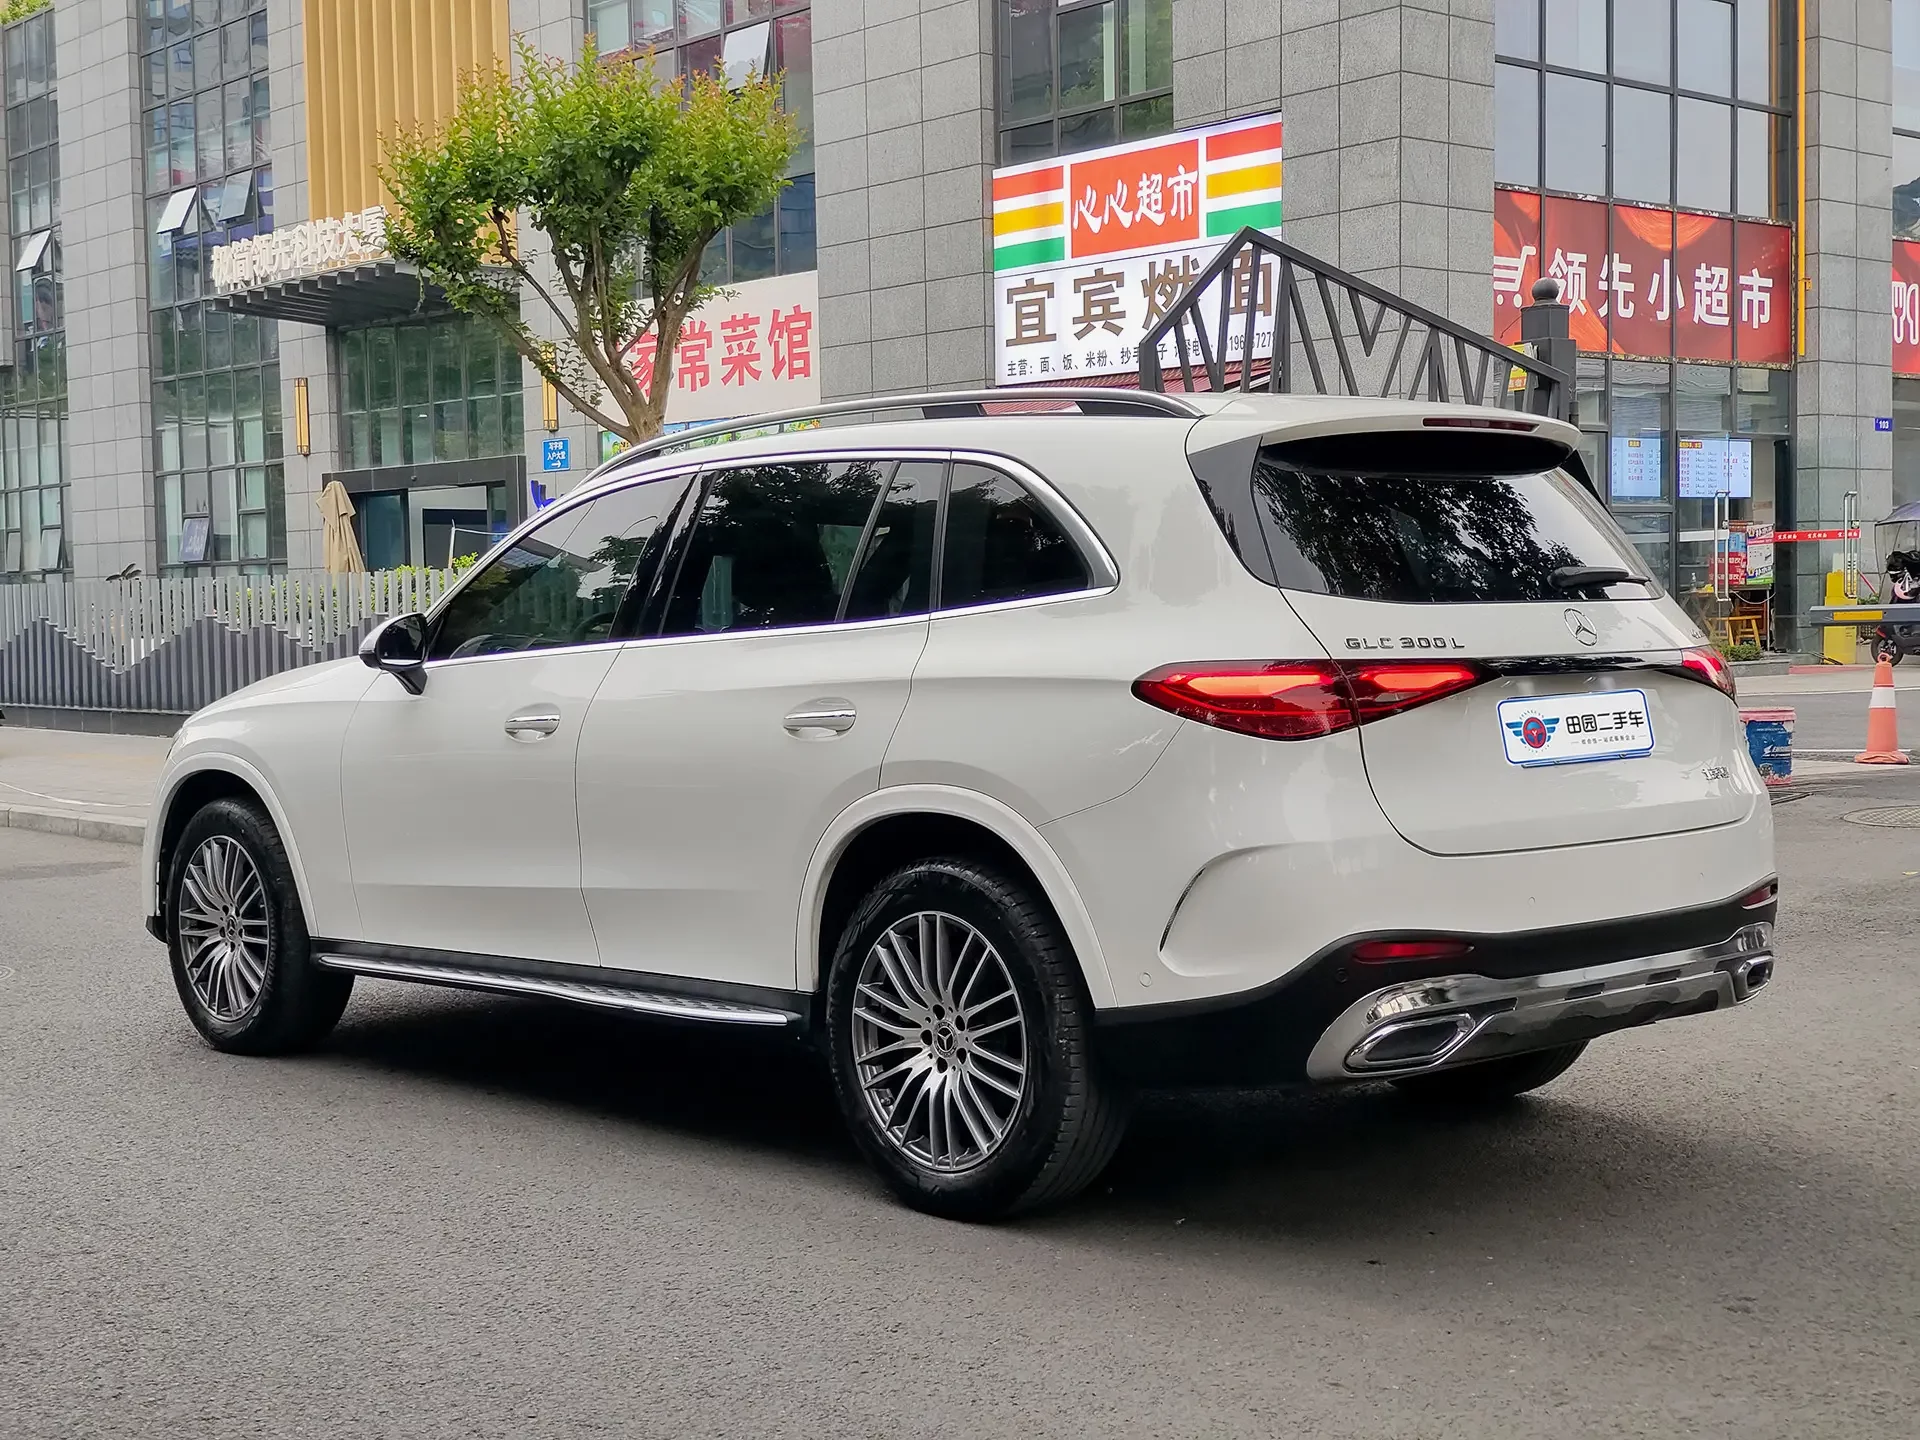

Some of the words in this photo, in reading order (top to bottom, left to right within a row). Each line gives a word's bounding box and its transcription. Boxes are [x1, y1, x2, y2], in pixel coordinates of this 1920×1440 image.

[1073, 164, 1198, 234] 心心超市
[1005, 249, 1273, 348] 宜宾燃面
[1547, 247, 1773, 329] 领先小超市
[616, 304, 812, 398] 家常菜馆
[1344, 637, 1394, 649] GLC
[1399, 637, 1447, 649] 300
[1449, 637, 1465, 649] L
[1566, 710, 1645, 735] 田园二手车
